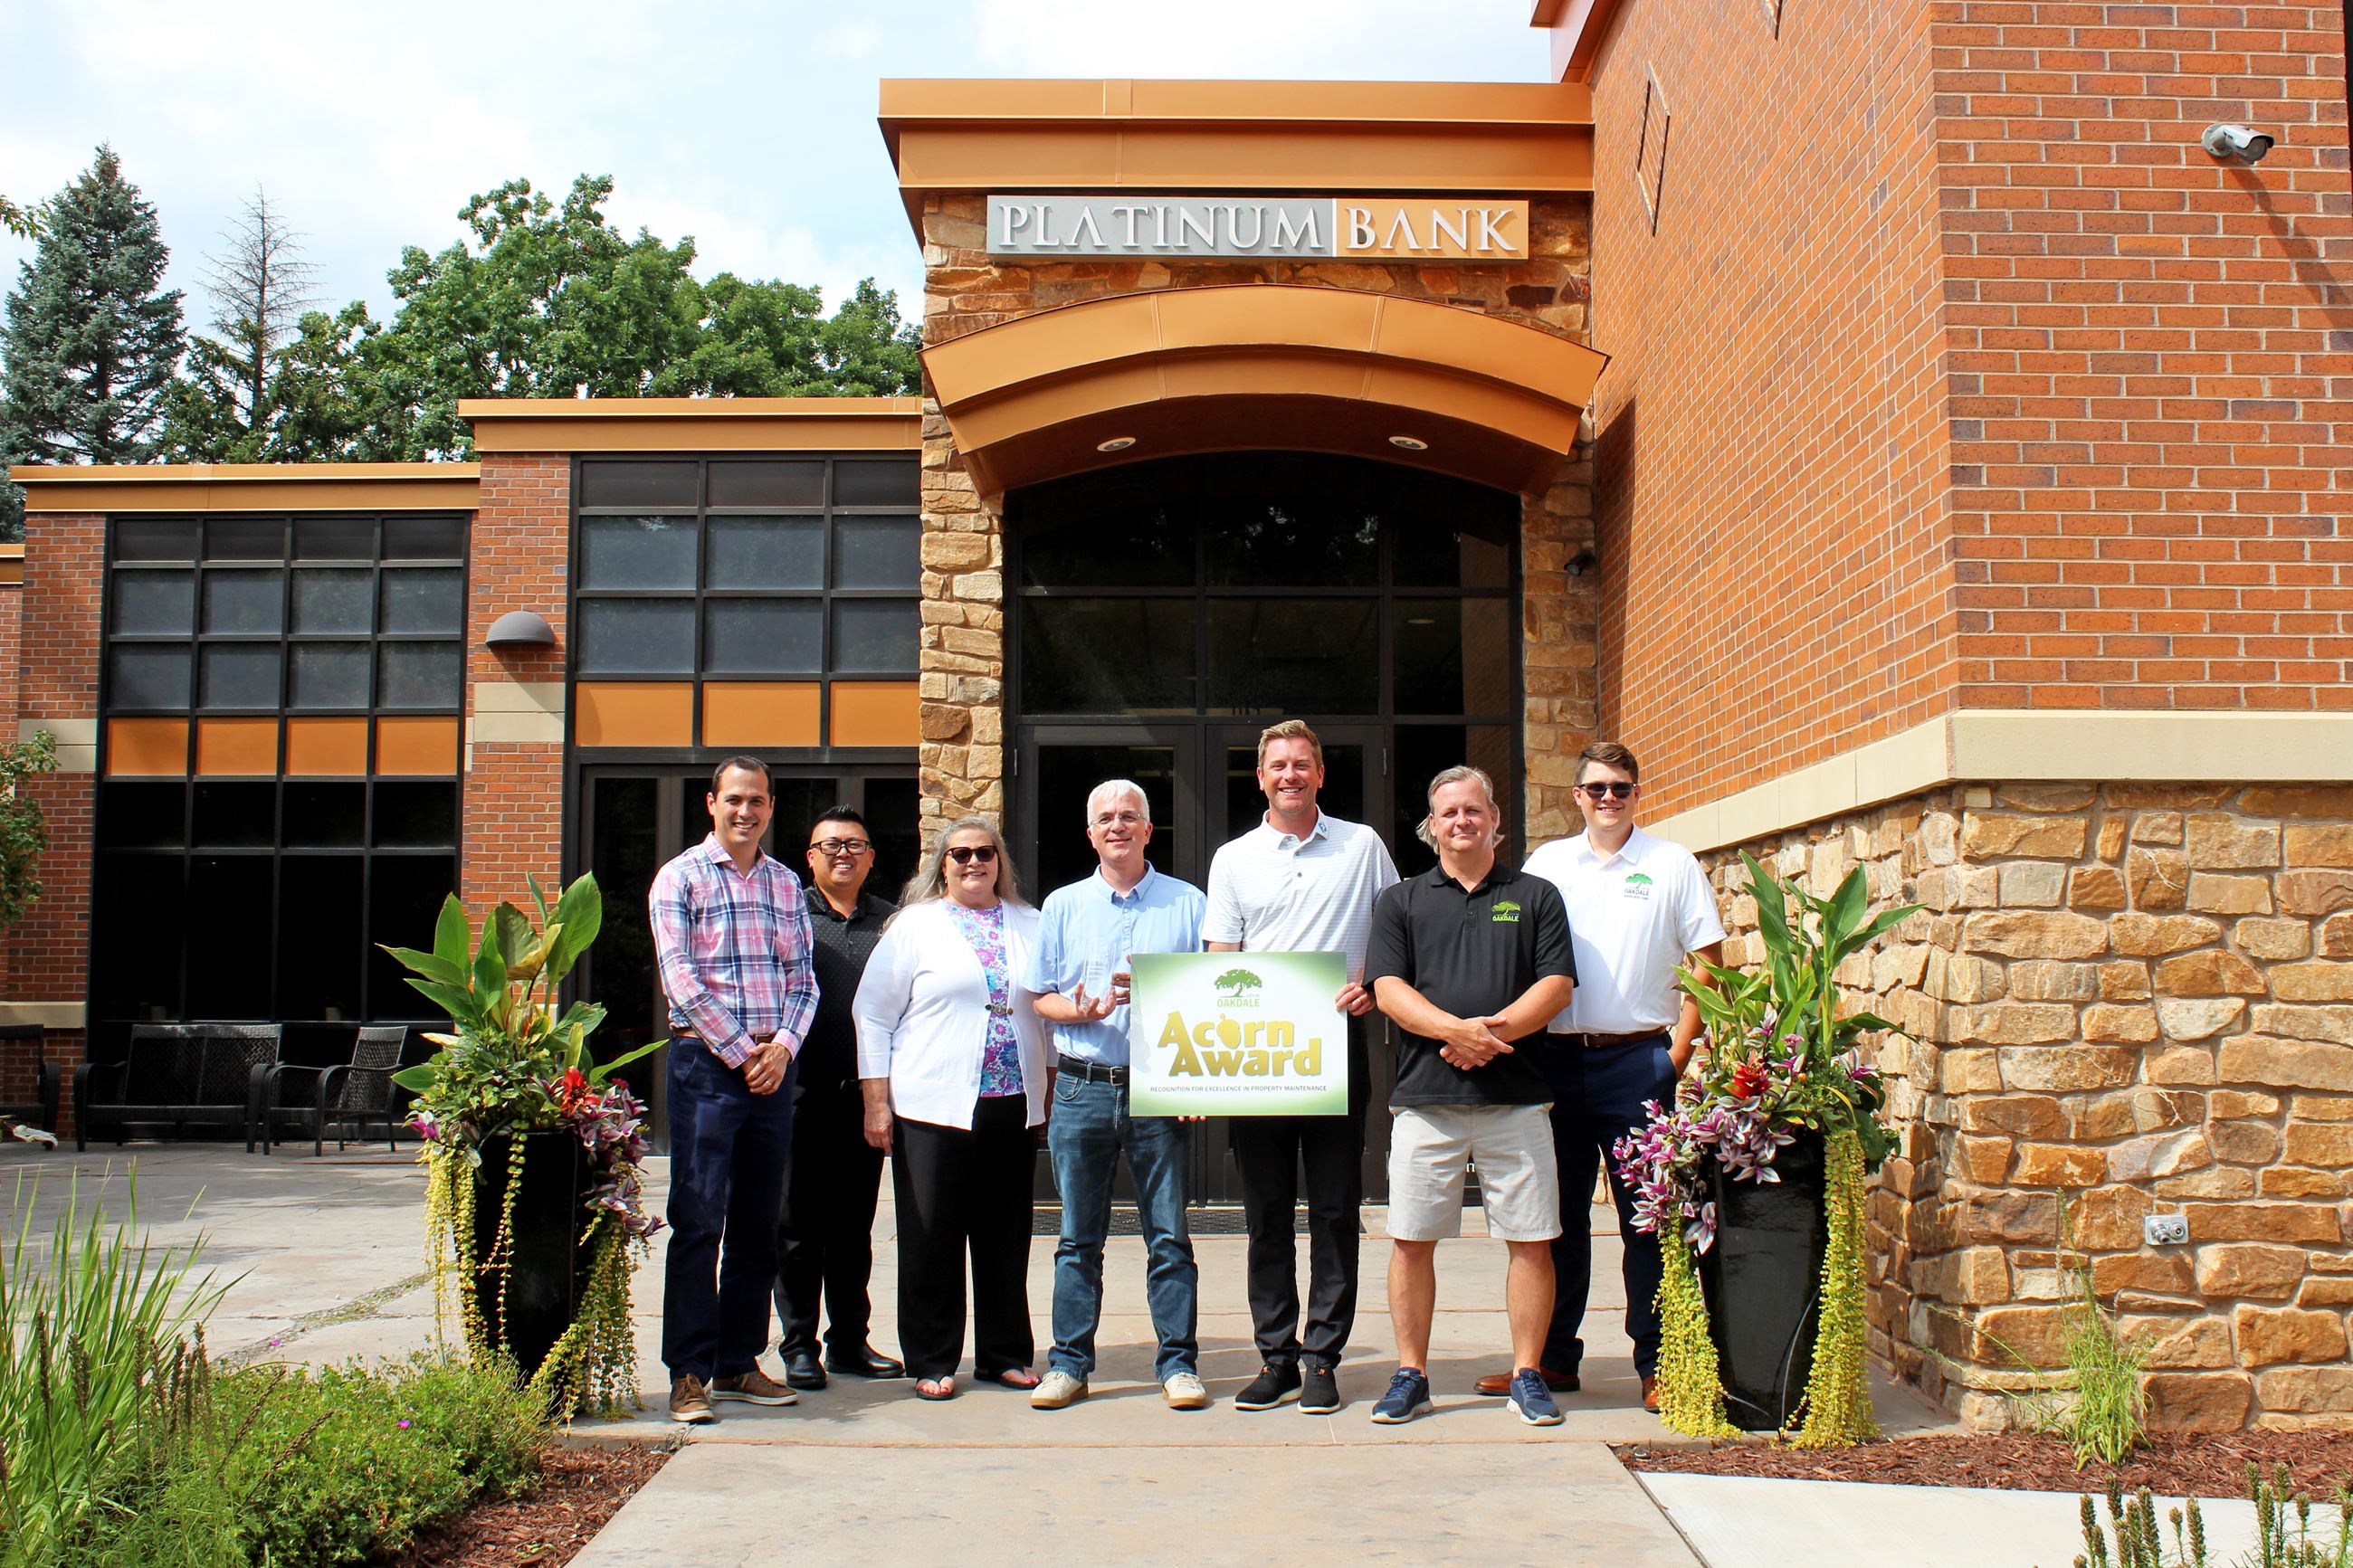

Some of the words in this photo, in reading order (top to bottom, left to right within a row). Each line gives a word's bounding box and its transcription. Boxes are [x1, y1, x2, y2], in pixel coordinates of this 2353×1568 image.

[998, 204, 1324, 249] PLATINUM
[1345, 207, 1519, 252] BANK
[1216, 998, 1260, 1008] OAKDALE
[1157, 1010, 1295, 1049] Acorn
[1168, 1037, 1322, 1077] Award
